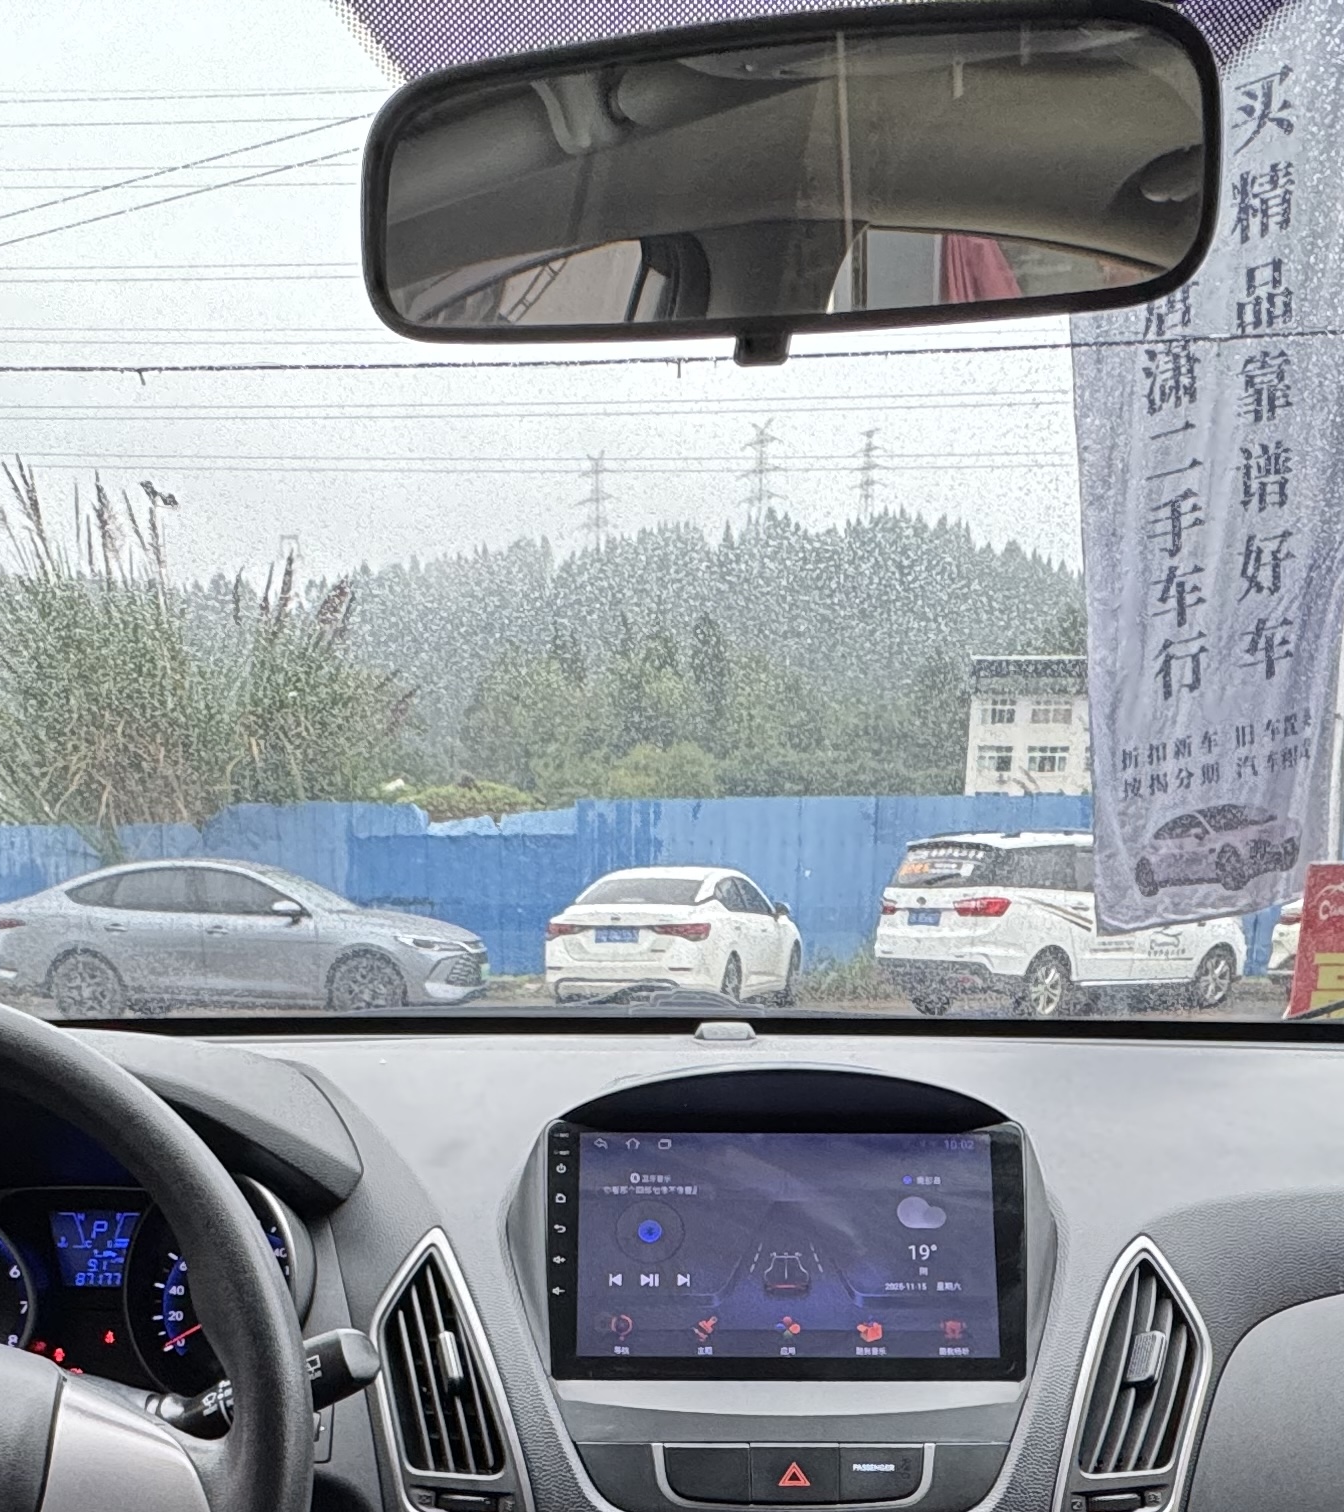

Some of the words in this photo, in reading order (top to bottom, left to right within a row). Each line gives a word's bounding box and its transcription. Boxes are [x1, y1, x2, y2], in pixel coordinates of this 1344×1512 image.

[1231, 64, 1296, 680] 买精品靠谱好车
[90, 1220, 109, 1239] P
[9, 1265, 21, 1279] 6
[168, 1284, 186, 1296] 40
[19, 1301, 28, 1315] 7
[167, 1310, 184, 1321] 20
